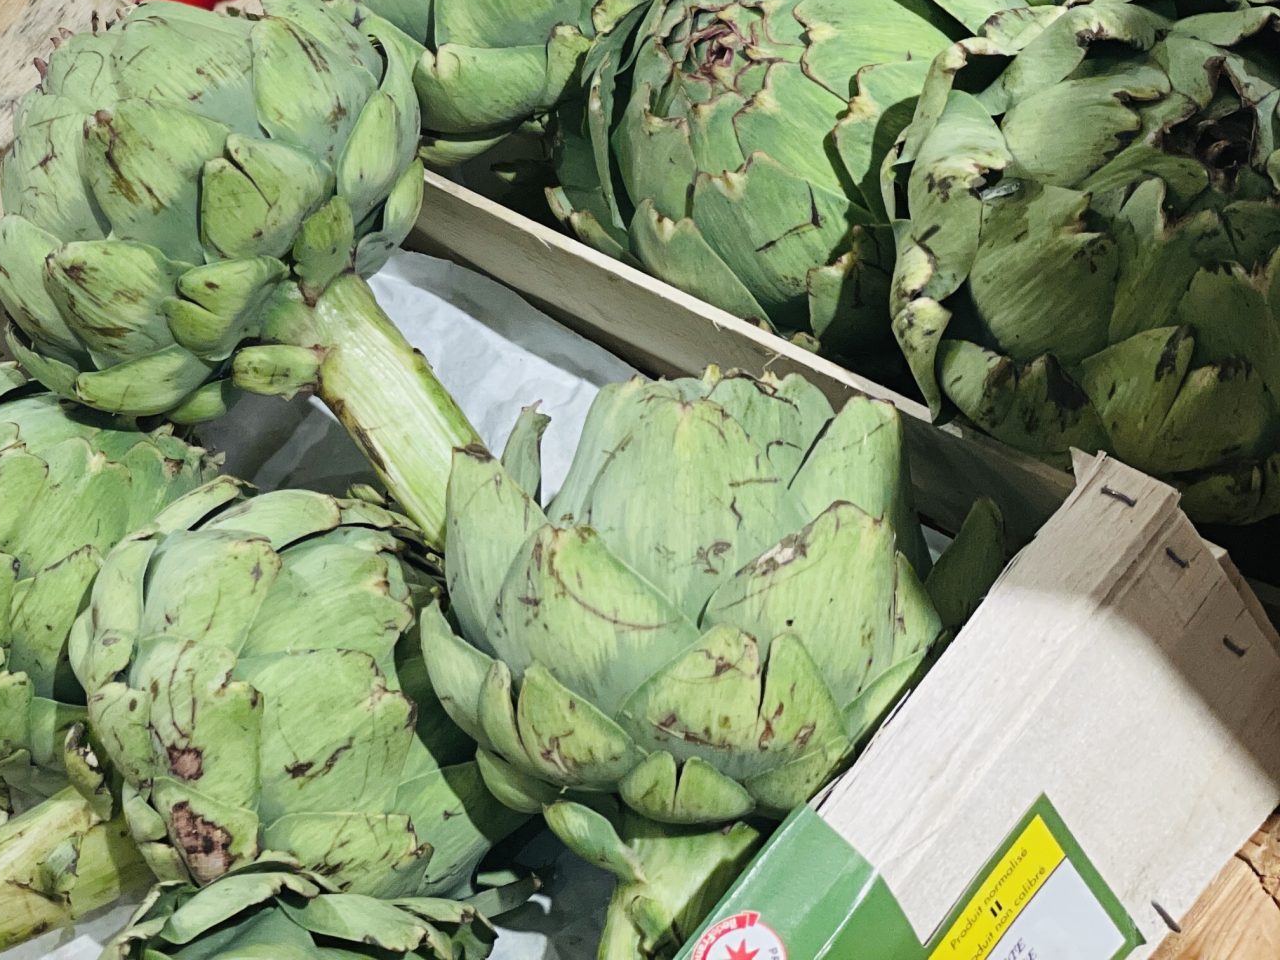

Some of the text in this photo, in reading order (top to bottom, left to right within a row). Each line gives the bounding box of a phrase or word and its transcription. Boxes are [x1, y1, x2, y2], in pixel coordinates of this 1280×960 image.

[950, 906, 983, 950] Produit
[983, 847, 1028, 907] normalisé
[995, 908, 1013, 932] non
[1014, 866, 1046, 907] calibré
